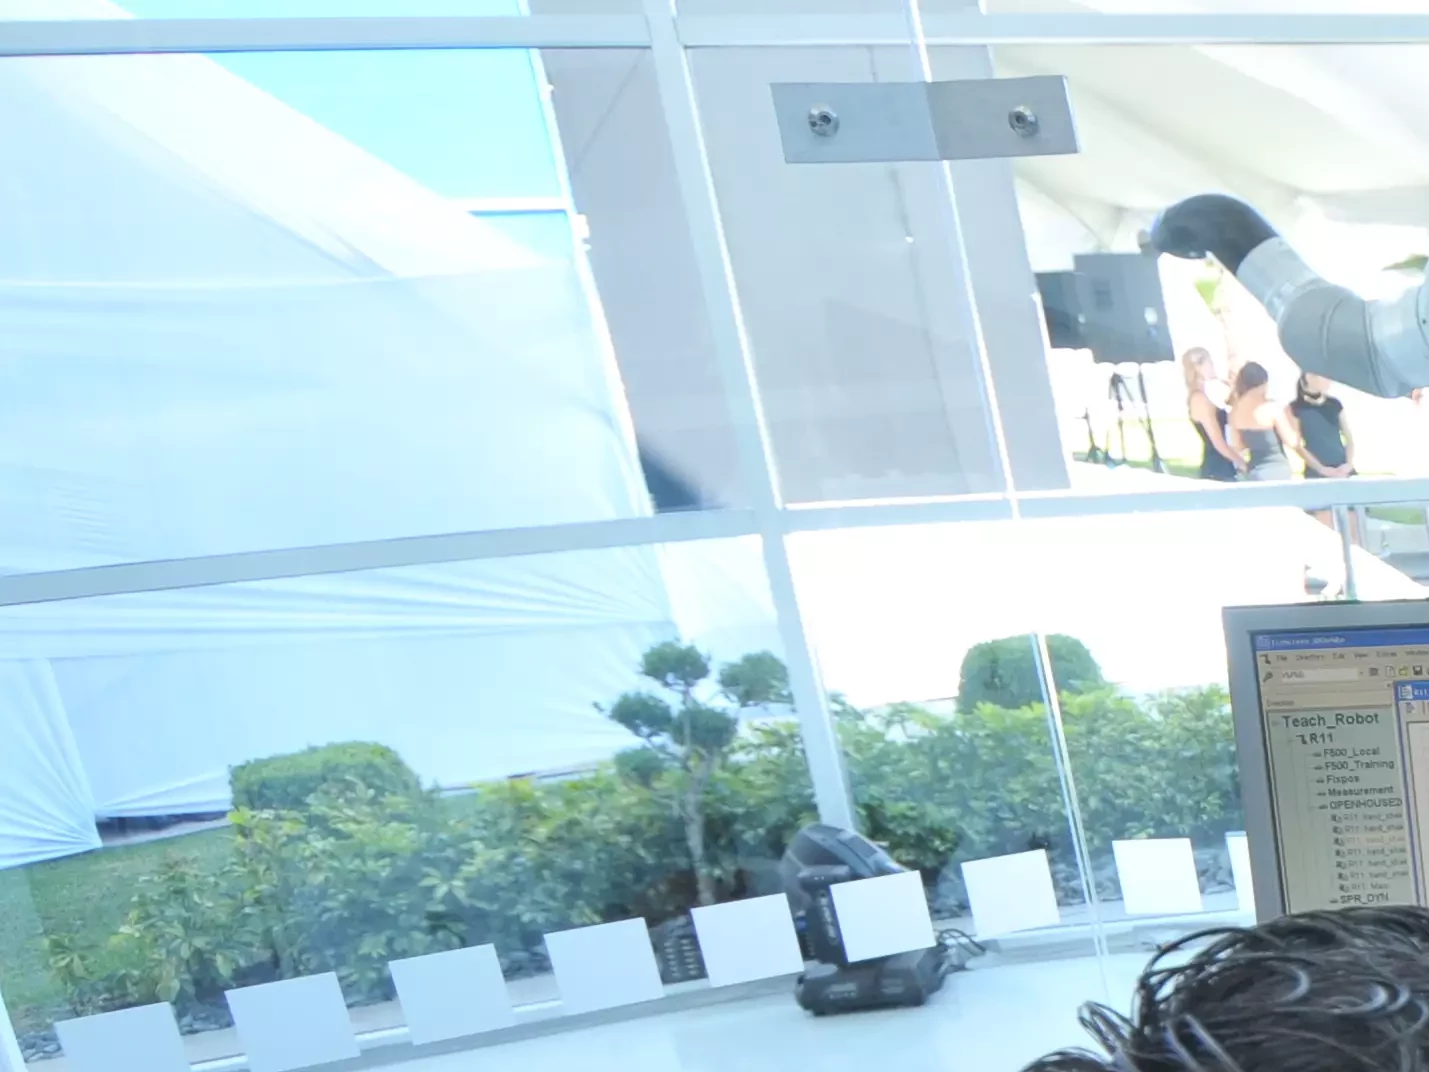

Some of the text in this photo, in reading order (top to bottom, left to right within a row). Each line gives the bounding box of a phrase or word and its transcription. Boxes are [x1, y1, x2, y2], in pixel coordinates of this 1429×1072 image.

[1281, 712, 1379, 729] Teach_Robot
[1309, 732, 1333, 744] R11
[1323, 746, 1380, 759] F500_Local
[1325, 760, 1395, 772] F500_Training
[1328, 786, 1394, 796] Measurement
